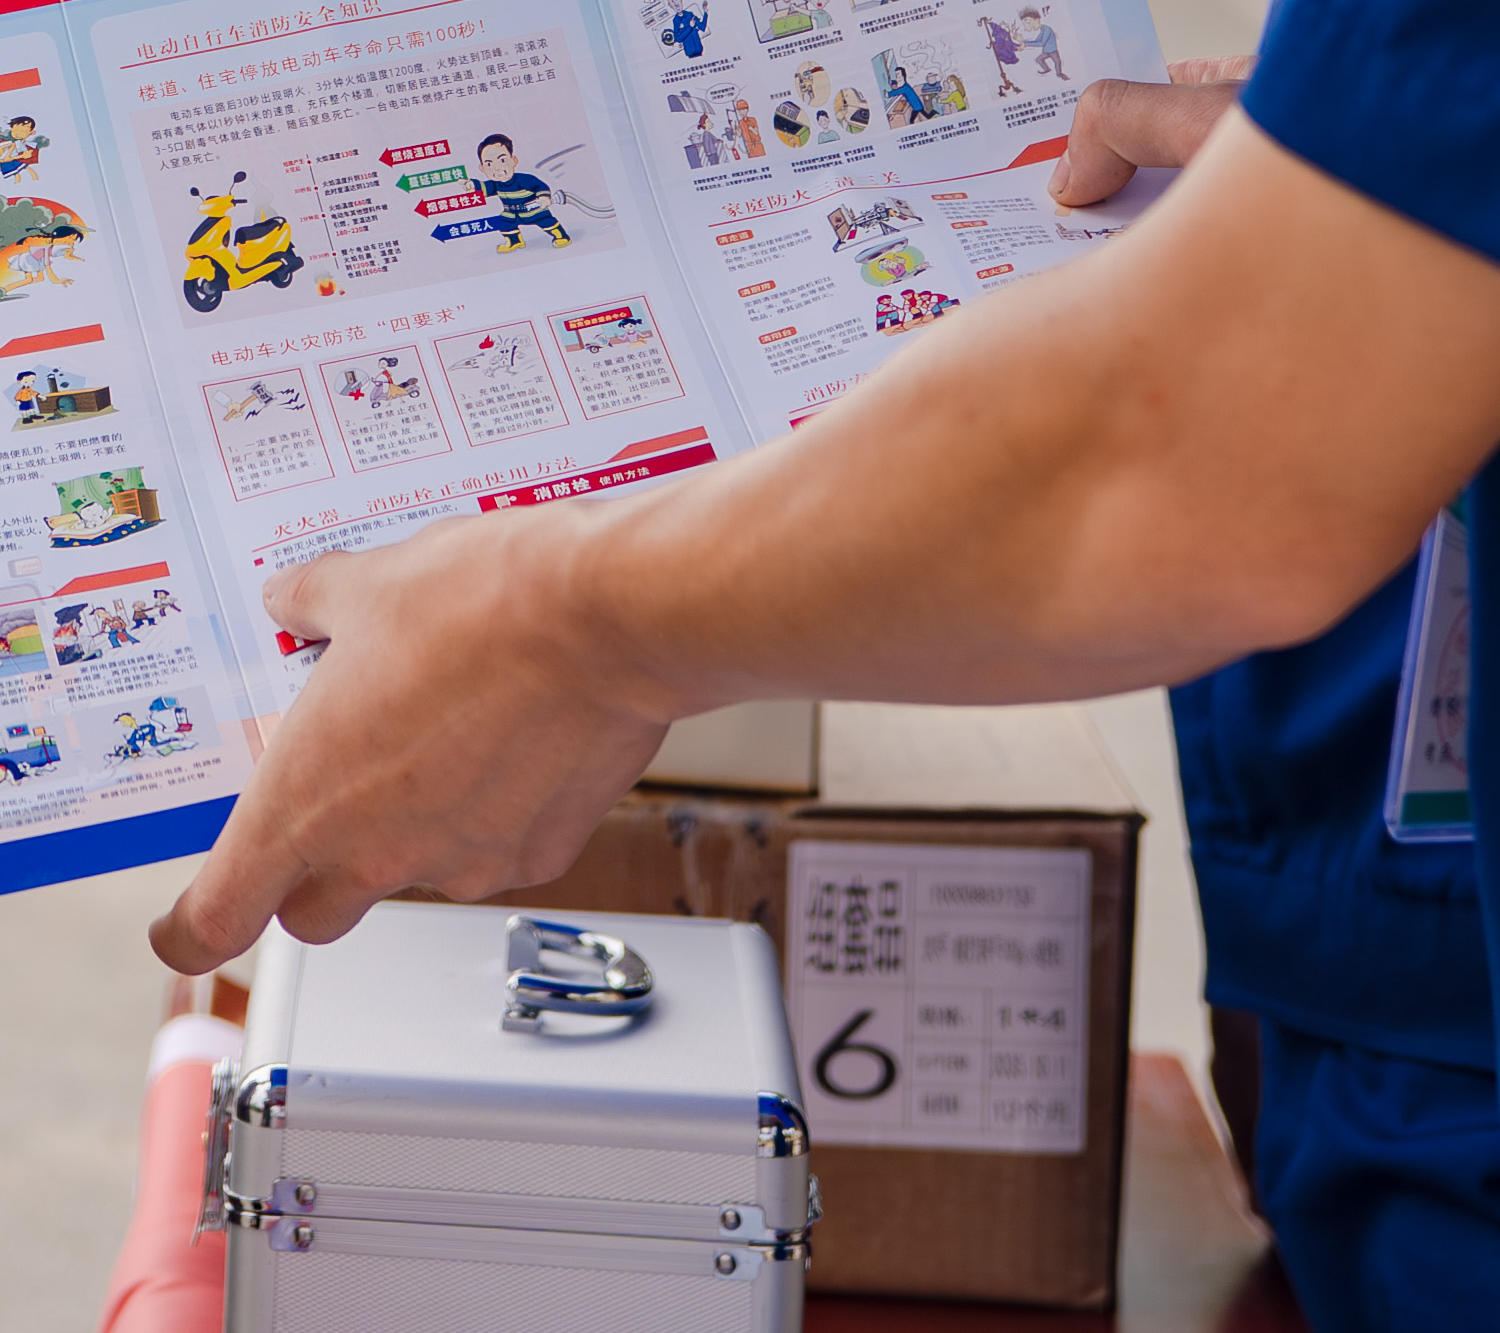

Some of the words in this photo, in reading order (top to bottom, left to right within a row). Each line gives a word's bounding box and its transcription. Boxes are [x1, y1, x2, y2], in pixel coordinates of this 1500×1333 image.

[391, 142, 447, 162] 燃烧温度高
[409, 168, 464, 188] 蔓延速度快
[426, 193, 482, 213] 烟雾毒性大
[722, 171, 901, 217] 家庭防火三清三关
[449, 219, 493, 237] 会毒死人
[804, 373, 868, 402] 消防
[532, 478, 591, 501] 消防栓
[599, 466, 650, 486] 使用方法
[812, 1007, 897, 1101] 6
